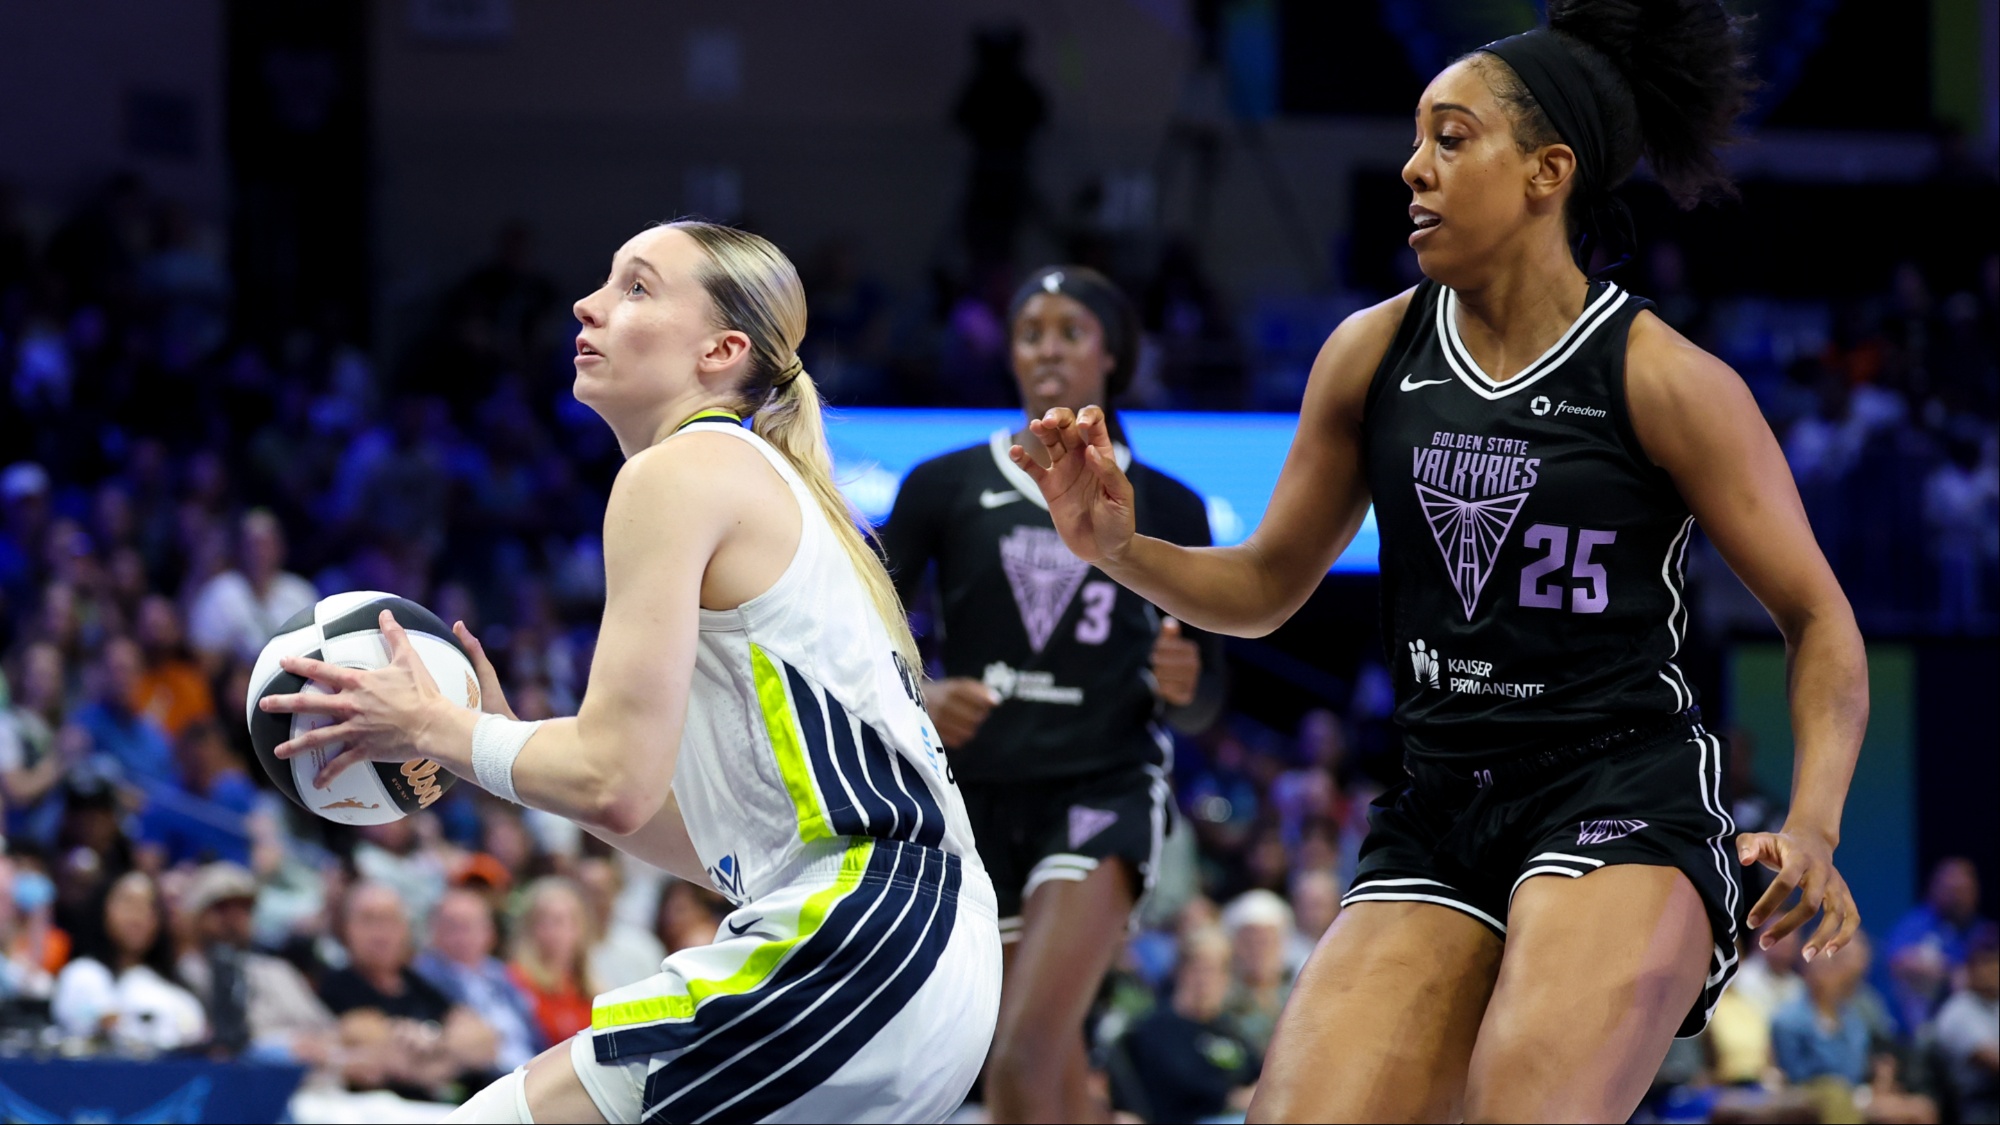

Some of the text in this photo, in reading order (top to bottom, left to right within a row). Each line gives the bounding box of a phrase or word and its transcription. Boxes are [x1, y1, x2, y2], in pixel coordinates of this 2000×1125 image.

[1554, 400, 1606, 418] freedom
[1431, 431, 1529, 455] GOLDEN STATE
[1412, 446, 1541, 499] VALKYRIES
[1519, 523, 1617, 613] 25
[1075, 581, 1116, 644] 3
[1447, 658, 1493, 678] KAISER
